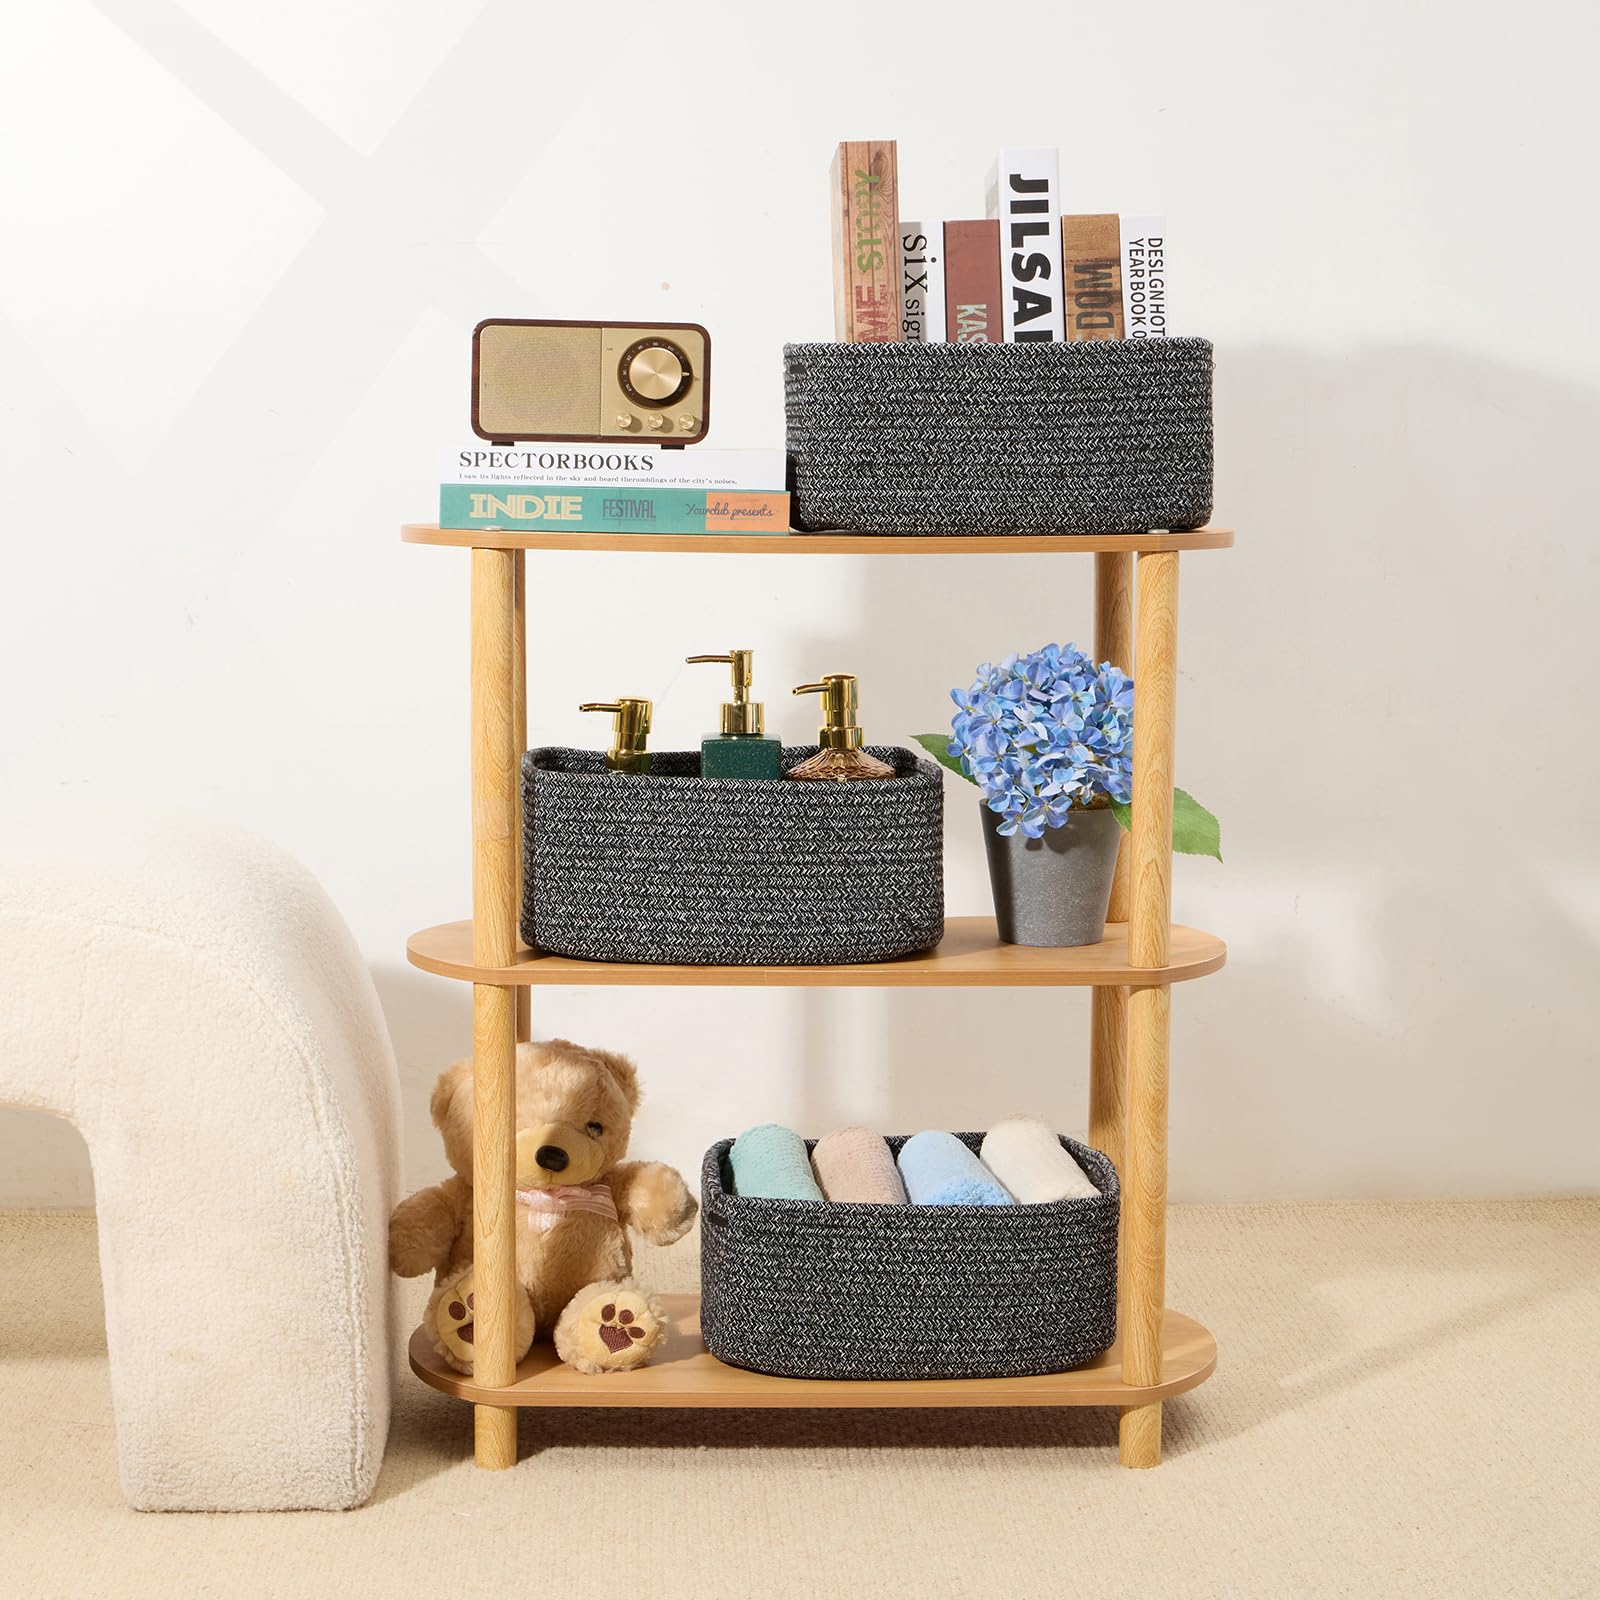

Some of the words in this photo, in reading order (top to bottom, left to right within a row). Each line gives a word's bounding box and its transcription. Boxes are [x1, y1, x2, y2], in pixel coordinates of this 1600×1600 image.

[855, 169, 884, 273] STORY
[459, 451, 654, 472] SPECTORBOOKS
[491, 473, 512, 481] lights
[469, 493, 583, 521] INDIE
[602, 498, 656, 519] FESTIVAL
[729, 504, 774, 520] presents
